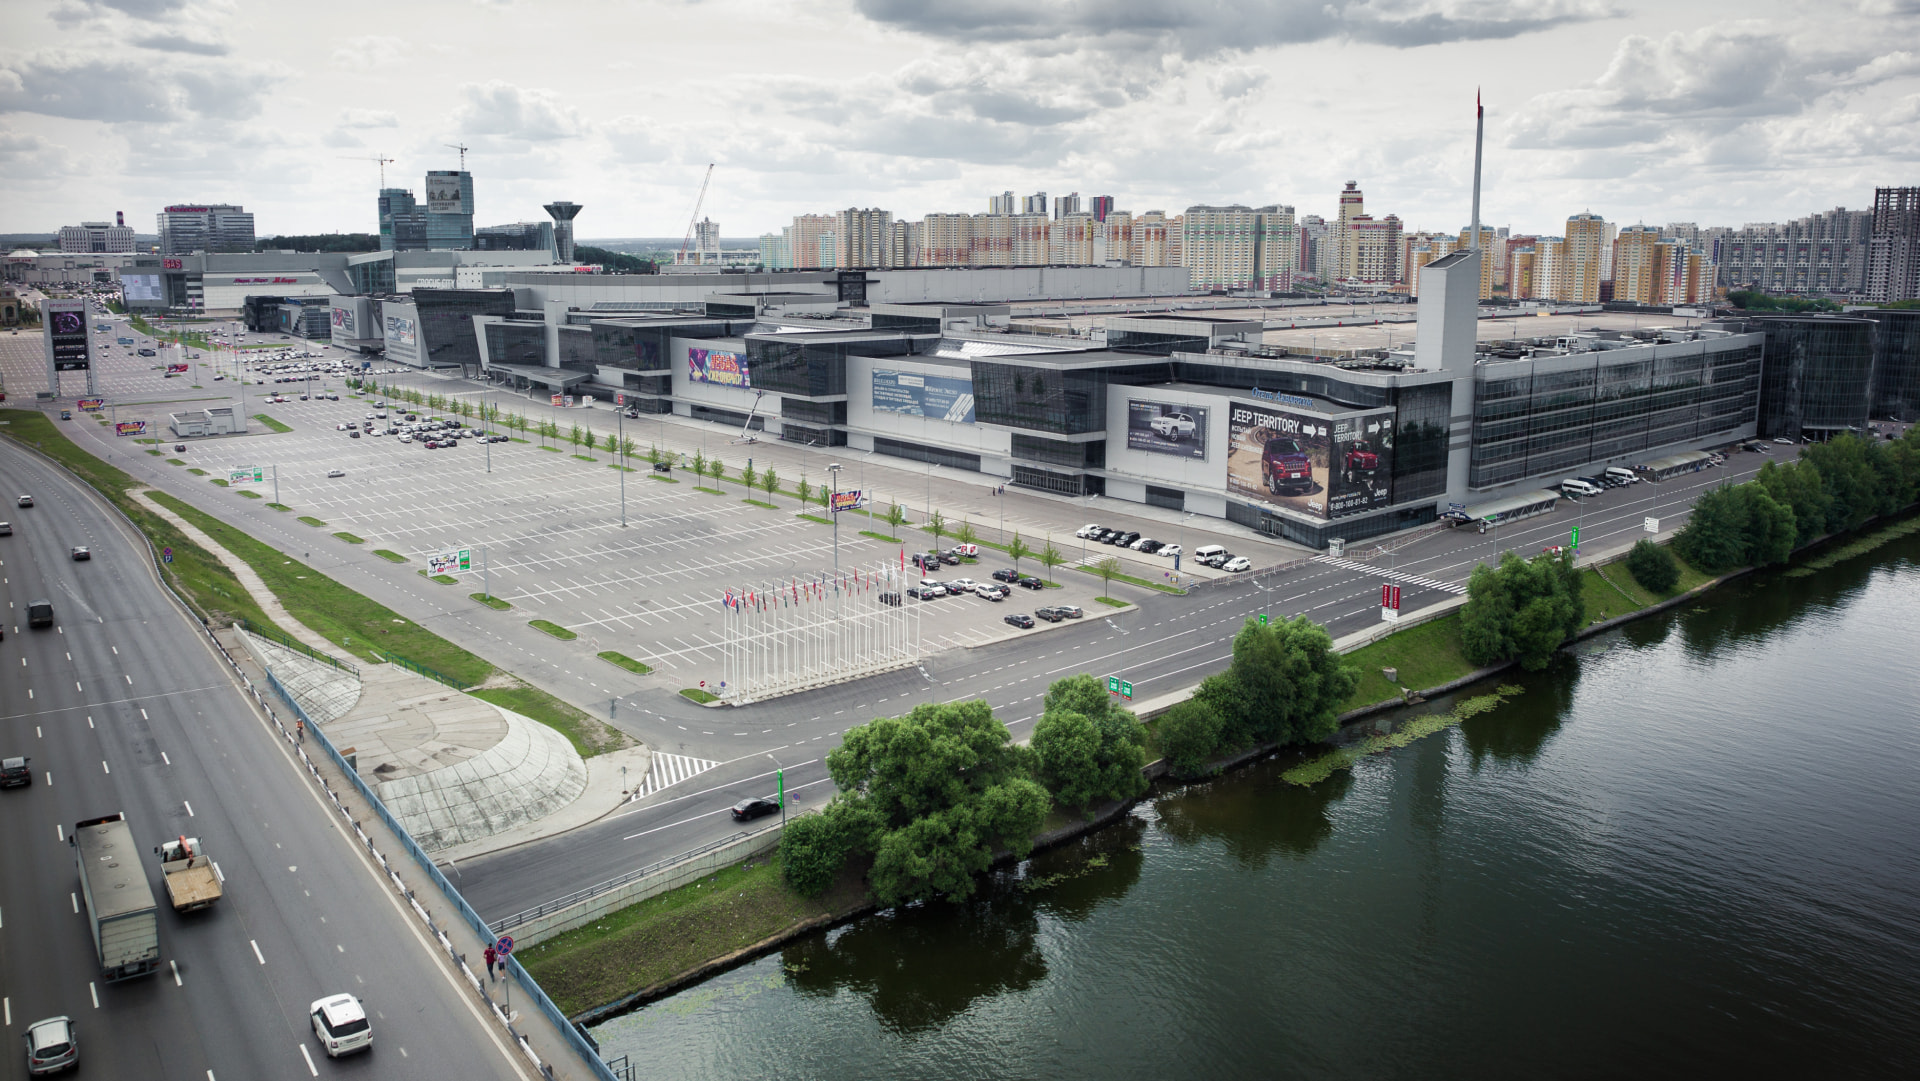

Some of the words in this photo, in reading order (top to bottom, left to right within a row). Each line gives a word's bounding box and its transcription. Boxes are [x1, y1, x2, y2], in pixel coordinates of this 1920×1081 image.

[1232, 408, 1252, 424] JEEP
[1253, 412, 1300, 434] TERRITORY
[1335, 423, 1348, 434] JEEP
[1334, 431, 1363, 443] TERRITORY
[1374, 488, 1388, 498] Jeep
[1307, 499, 1323, 512] Jeep
